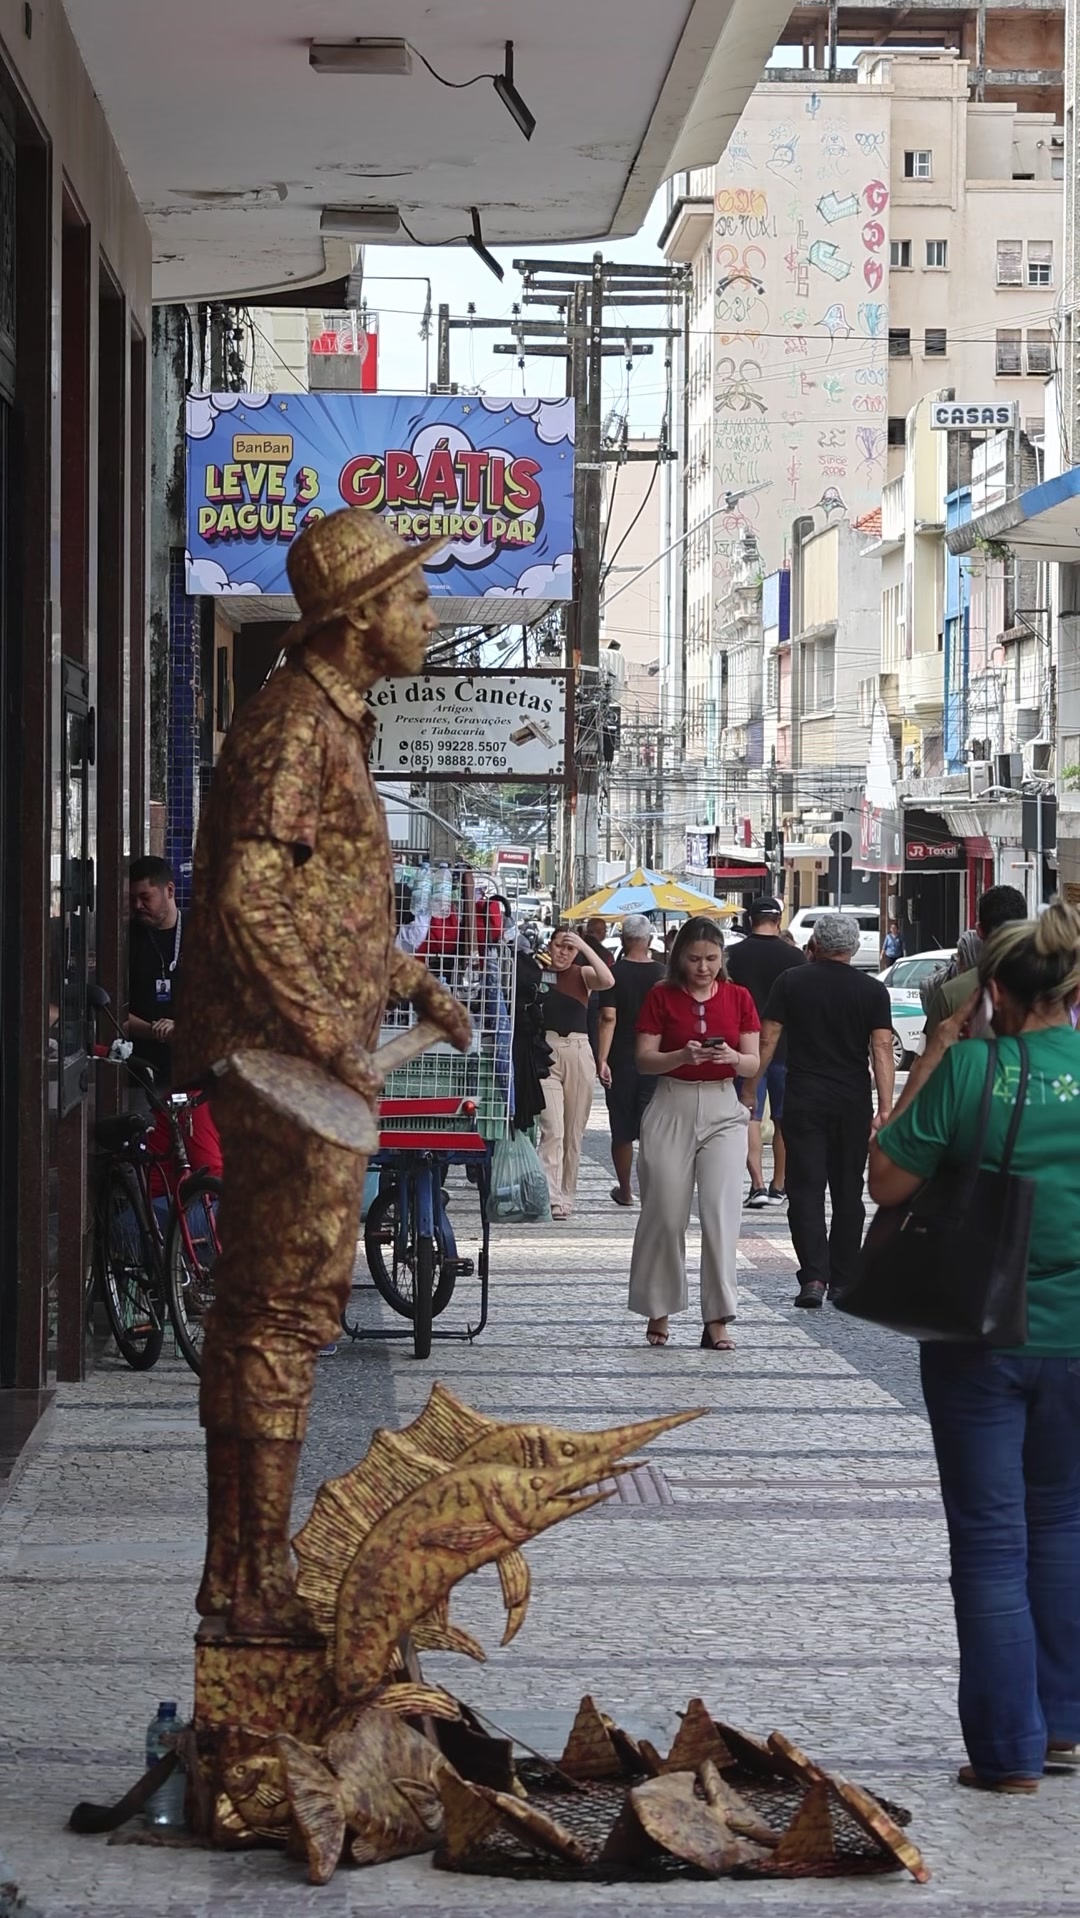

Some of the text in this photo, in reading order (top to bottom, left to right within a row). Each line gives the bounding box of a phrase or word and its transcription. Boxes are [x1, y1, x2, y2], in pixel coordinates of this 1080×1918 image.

[936, 407, 1010, 424] CASAS
[236, 440, 290, 457] BanBan
[818, 455, 848, 467] Since
[338, 438, 543, 515] GRÁTIS
[821, 466, 847, 476] 2006
[205, 463, 321, 504] LEVE 3
[198, 504, 298, 538] PAGUE
[385, 512, 537, 544] ERCEIRO PAR
[405, 682, 446, 703] das
[454, 681, 553, 714] Canetas
[433, 704, 474, 714] Artigos
[394, 714, 512, 727] Presentes, Gravações
[420, 727, 486, 737] e Tabacaria
[410, 740, 507, 754] (85) 99228.5507
[410, 755, 507, 768] (85) 98882.0769
[908, 845, 924, 857] JR
